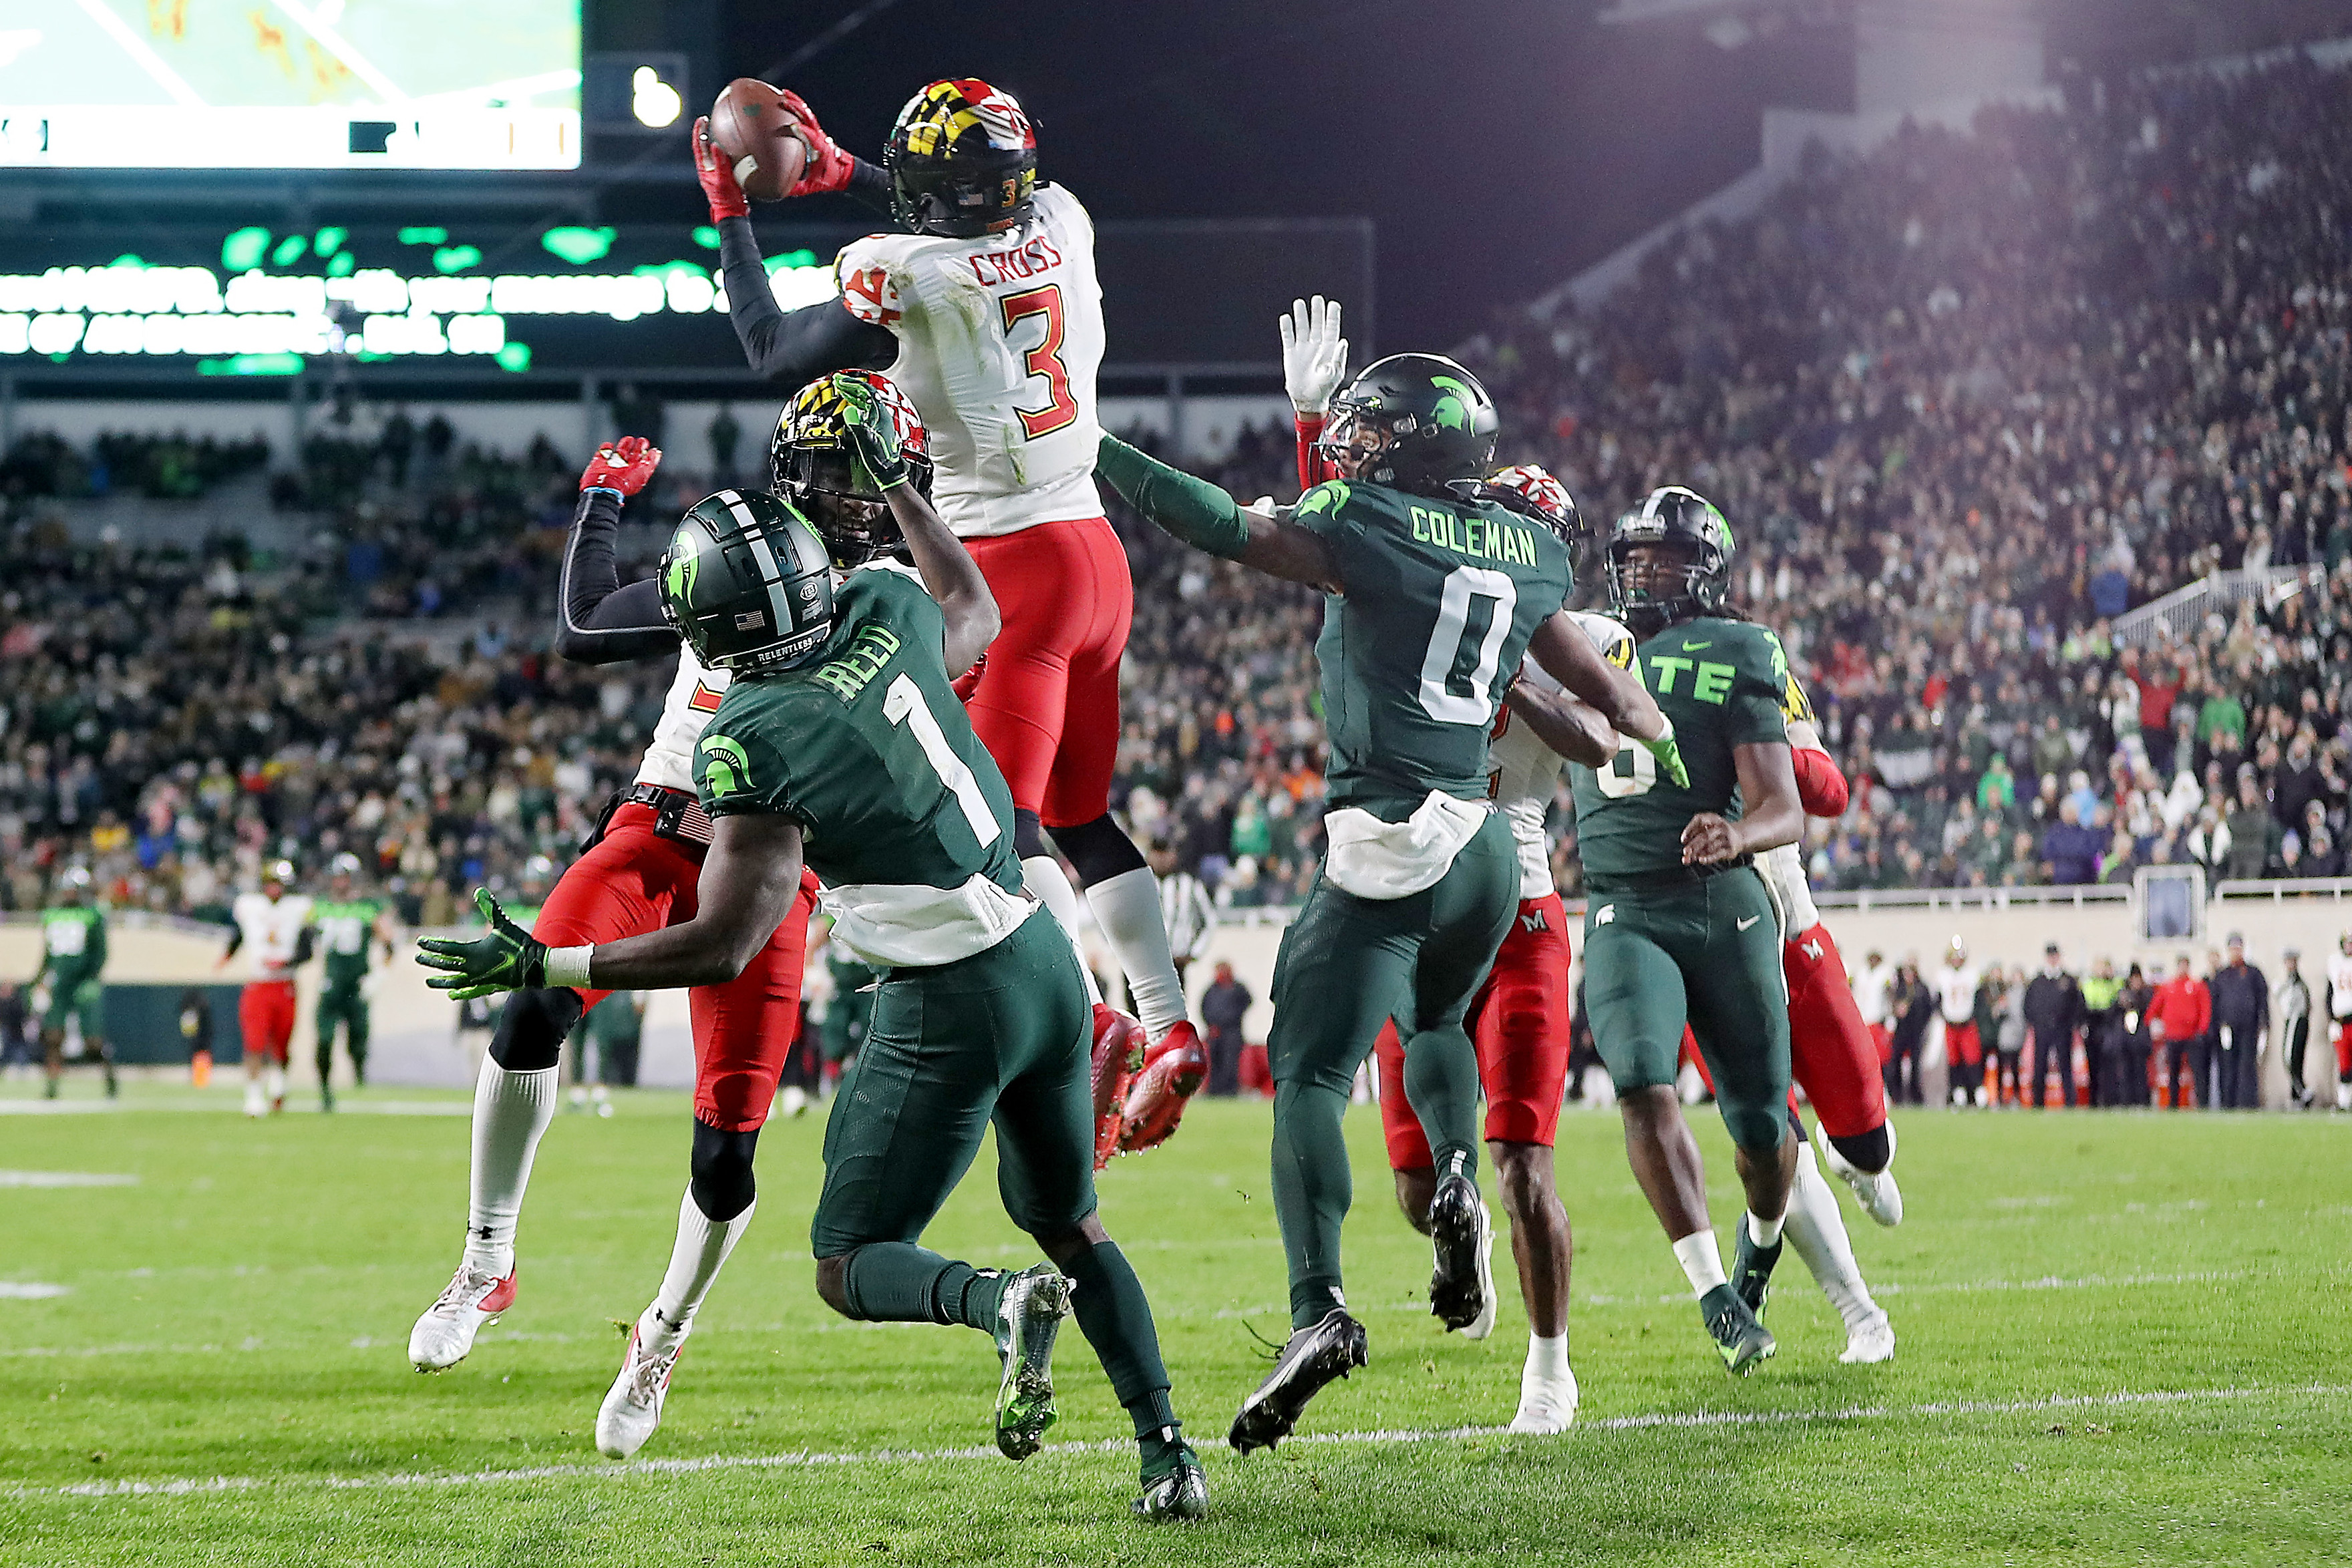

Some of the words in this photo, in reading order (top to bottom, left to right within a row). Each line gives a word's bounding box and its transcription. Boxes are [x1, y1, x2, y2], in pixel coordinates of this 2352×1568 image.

[1003, 178, 1016, 208] 3
[969, 236, 1061, 286] CROSS
[999, 282, 1078, 442] 3
[1409, 506, 1538, 568] COLEMAN
[757, 636, 814, 662] RELENTLESS
[816, 625, 901, 701] REED
[1418, 564, 1518, 727] 0
[1632, 654, 1736, 705] TE
[881, 670, 1003, 851] 1
